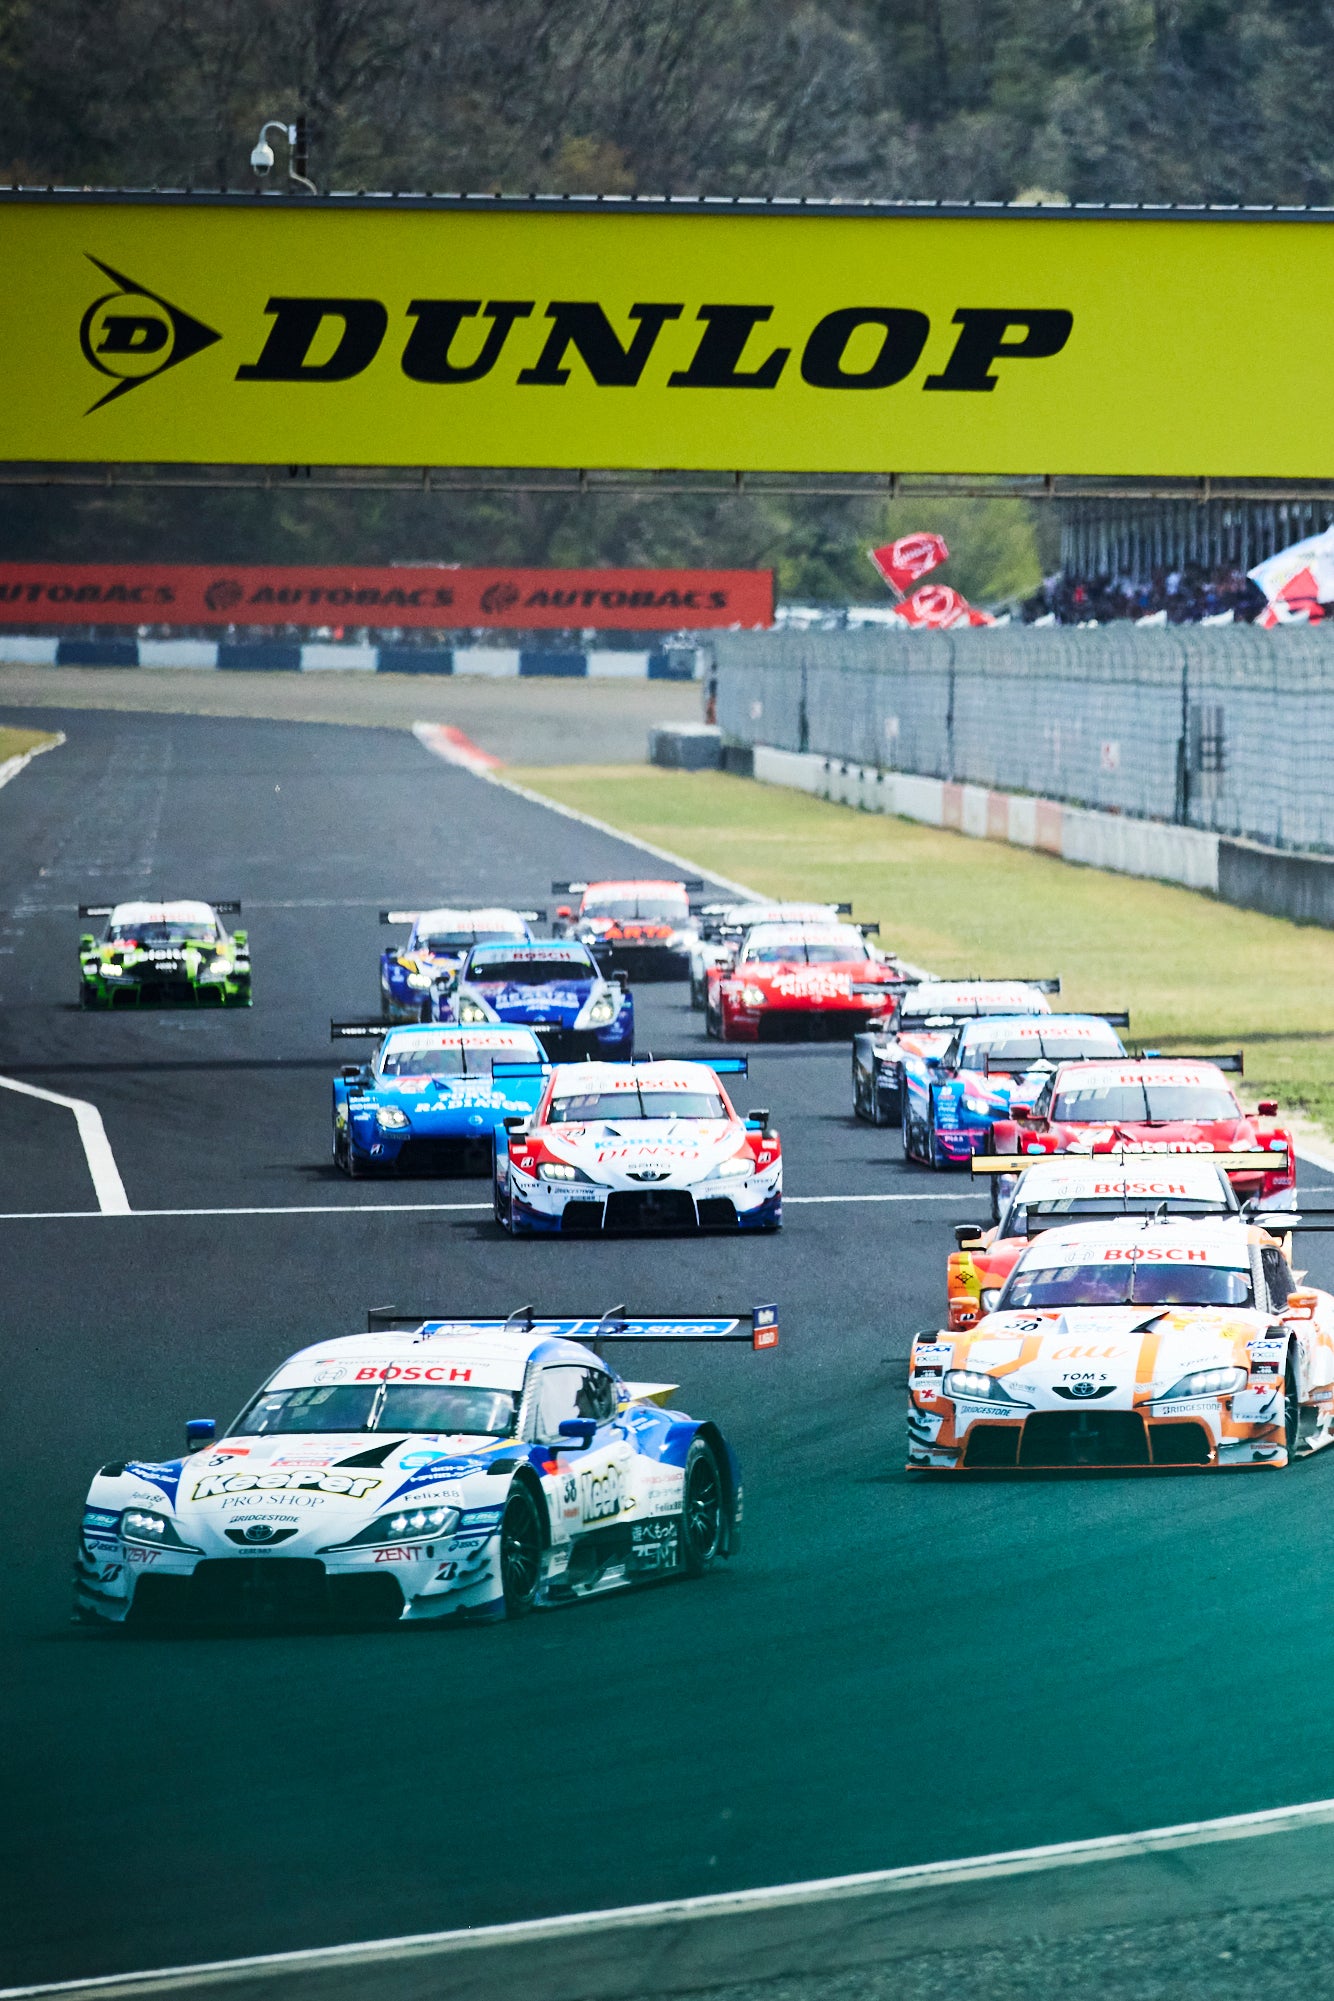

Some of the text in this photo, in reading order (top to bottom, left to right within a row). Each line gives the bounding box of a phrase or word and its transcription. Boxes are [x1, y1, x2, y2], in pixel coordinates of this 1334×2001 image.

[96, 315, 169, 354] D
[235, 297, 1074, 391] DUNLOP
[0, 584, 176, 604] UTOBACS
[248, 586, 455, 608] AUTOBACS
[523, 588, 730, 609] AUTOBACS
[614, 1080, 689, 1089] BOSCH
[1119, 1074, 1201, 1085] BOSCH
[597, 1147, 700, 1163] DENSO
[1110, 1141, 1215, 1154] Astemo
[1093, 1183, 1187, 1195] BOSCH
[1103, 1248, 1208, 1262] BOSCH
[643, 1325, 718, 1334] SHOP
[1050, 1345, 1129, 1361] au
[354, 1366, 472, 1382] BOSCH
[1162, 1402, 1222, 1415] BRIDGESTONE
[192, 1470, 384, 1501] KeePer
[221, 1494, 326, 1509] PRO SHOP
[404, 1490, 461, 1502] Felix88
[229, 1514, 301, 1524] BRIDGESTONE
[127, 1547, 162, 1565] ZENT
[372, 1546, 423, 1564] ZENT
